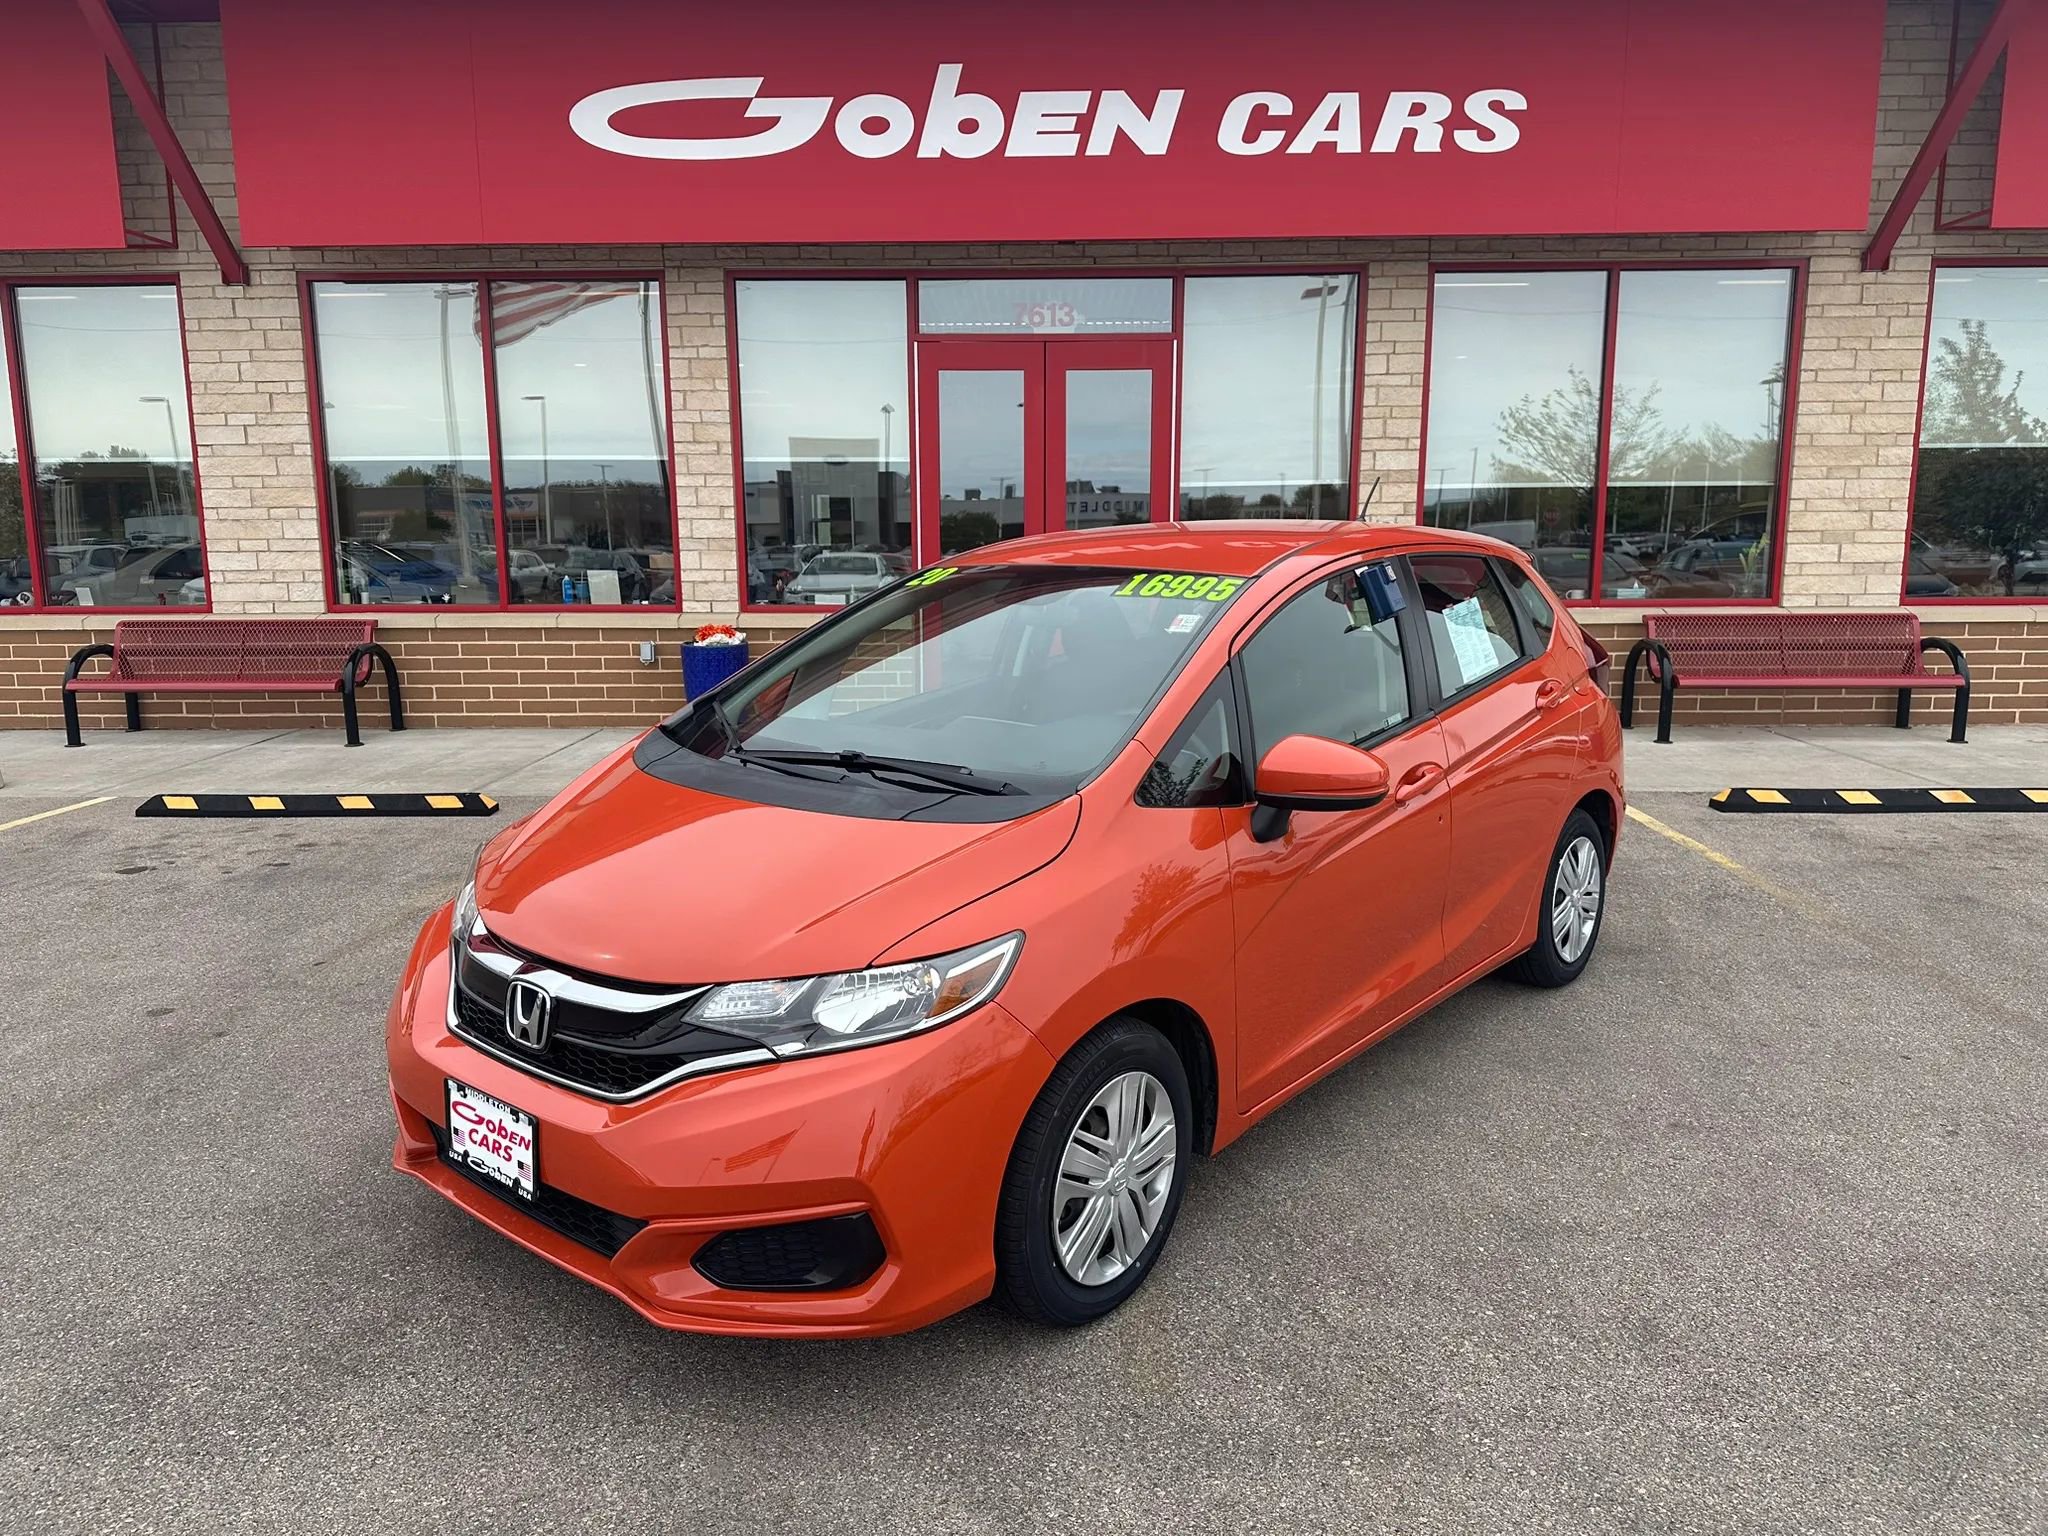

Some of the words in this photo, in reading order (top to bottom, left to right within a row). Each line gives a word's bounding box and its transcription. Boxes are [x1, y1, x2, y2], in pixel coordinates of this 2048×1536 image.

[1215, 88, 1529, 156] CARS
[1011, 302, 1076, 328] 7613
[904, 567, 959, 586] 20
[1114, 573, 1246, 601] 16995
[448, 1150, 463, 1163] USA
[468, 1128, 513, 1163] CARS
[517, 1187, 532, 1201] USA
